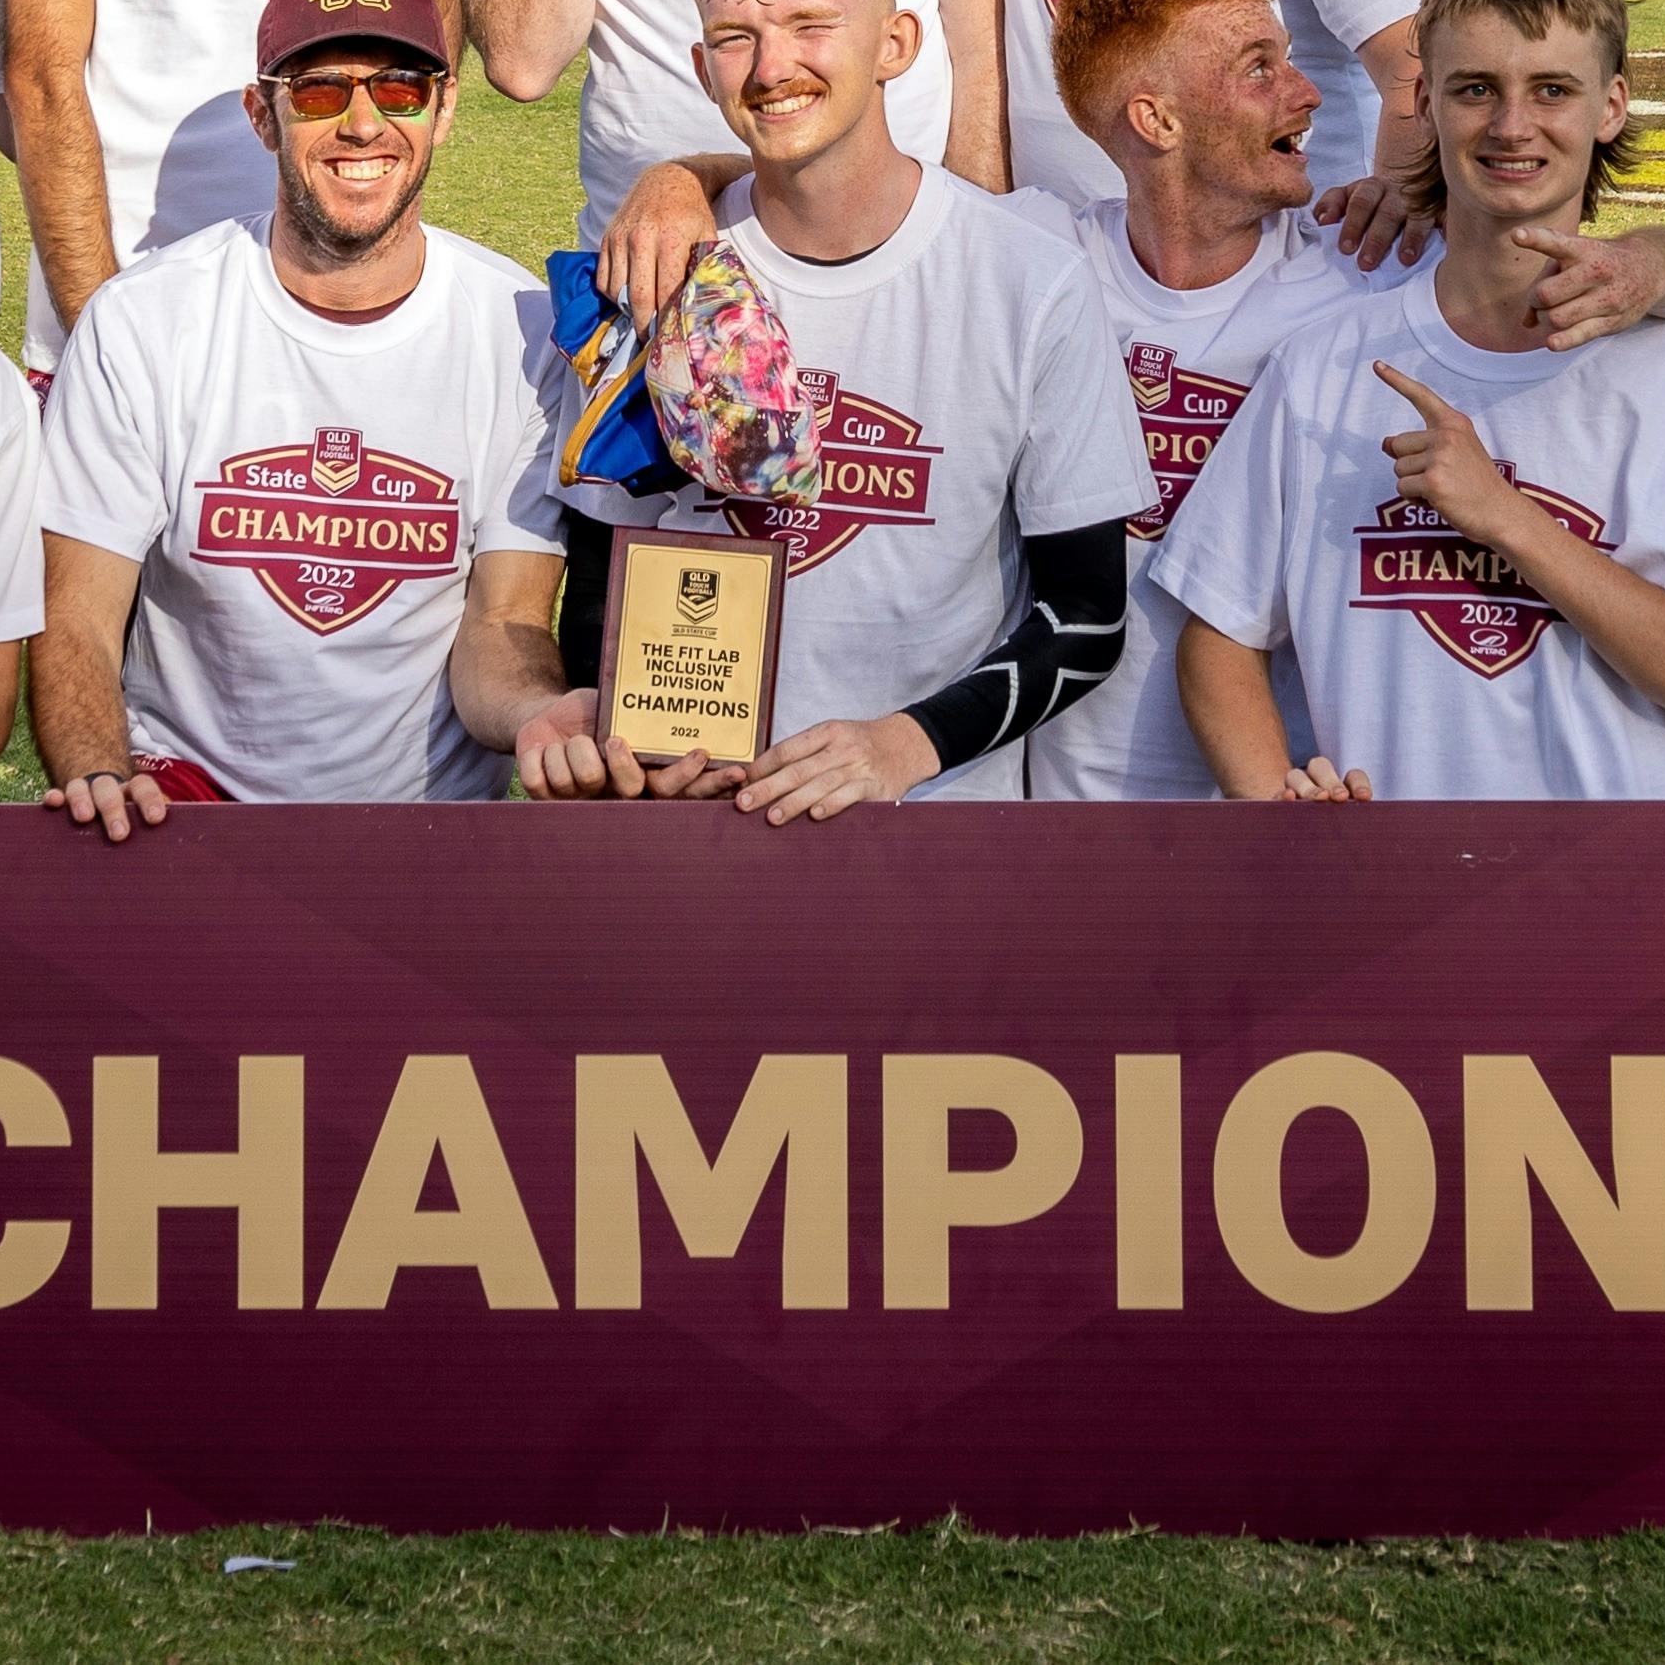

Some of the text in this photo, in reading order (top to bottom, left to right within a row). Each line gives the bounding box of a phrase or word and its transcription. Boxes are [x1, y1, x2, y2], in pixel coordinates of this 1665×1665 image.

[1141, 348, 1165, 362] QLD
[1134, 365, 1165, 379] FOOTBALL
[1140, 360, 1162, 370] TOUCH
[802, 373, 827, 385] QLD
[1183, 393, 1228, 418] Cup
[326, 431, 351, 445] QLD
[843, 416, 886, 445] Cup
[246, 465, 416, 503] State Cup
[764, 505, 821, 531] 2022
[210, 506, 448, 553] CHAMPIONS
[297, 564, 356, 589] 2022
[689, 572, 710, 583] QLD
[684, 587, 713, 595] FOOTBALL
[1460, 604, 1517, 626] 2022
[641, 643, 740, 662] THE FIT LAB
[646, 658, 733, 678] INCLUSIVE
[651, 675, 724, 692] DIVISION
[622, 693, 750, 719] CHAMPIONS
[671, 726, 700, 738] 2022
